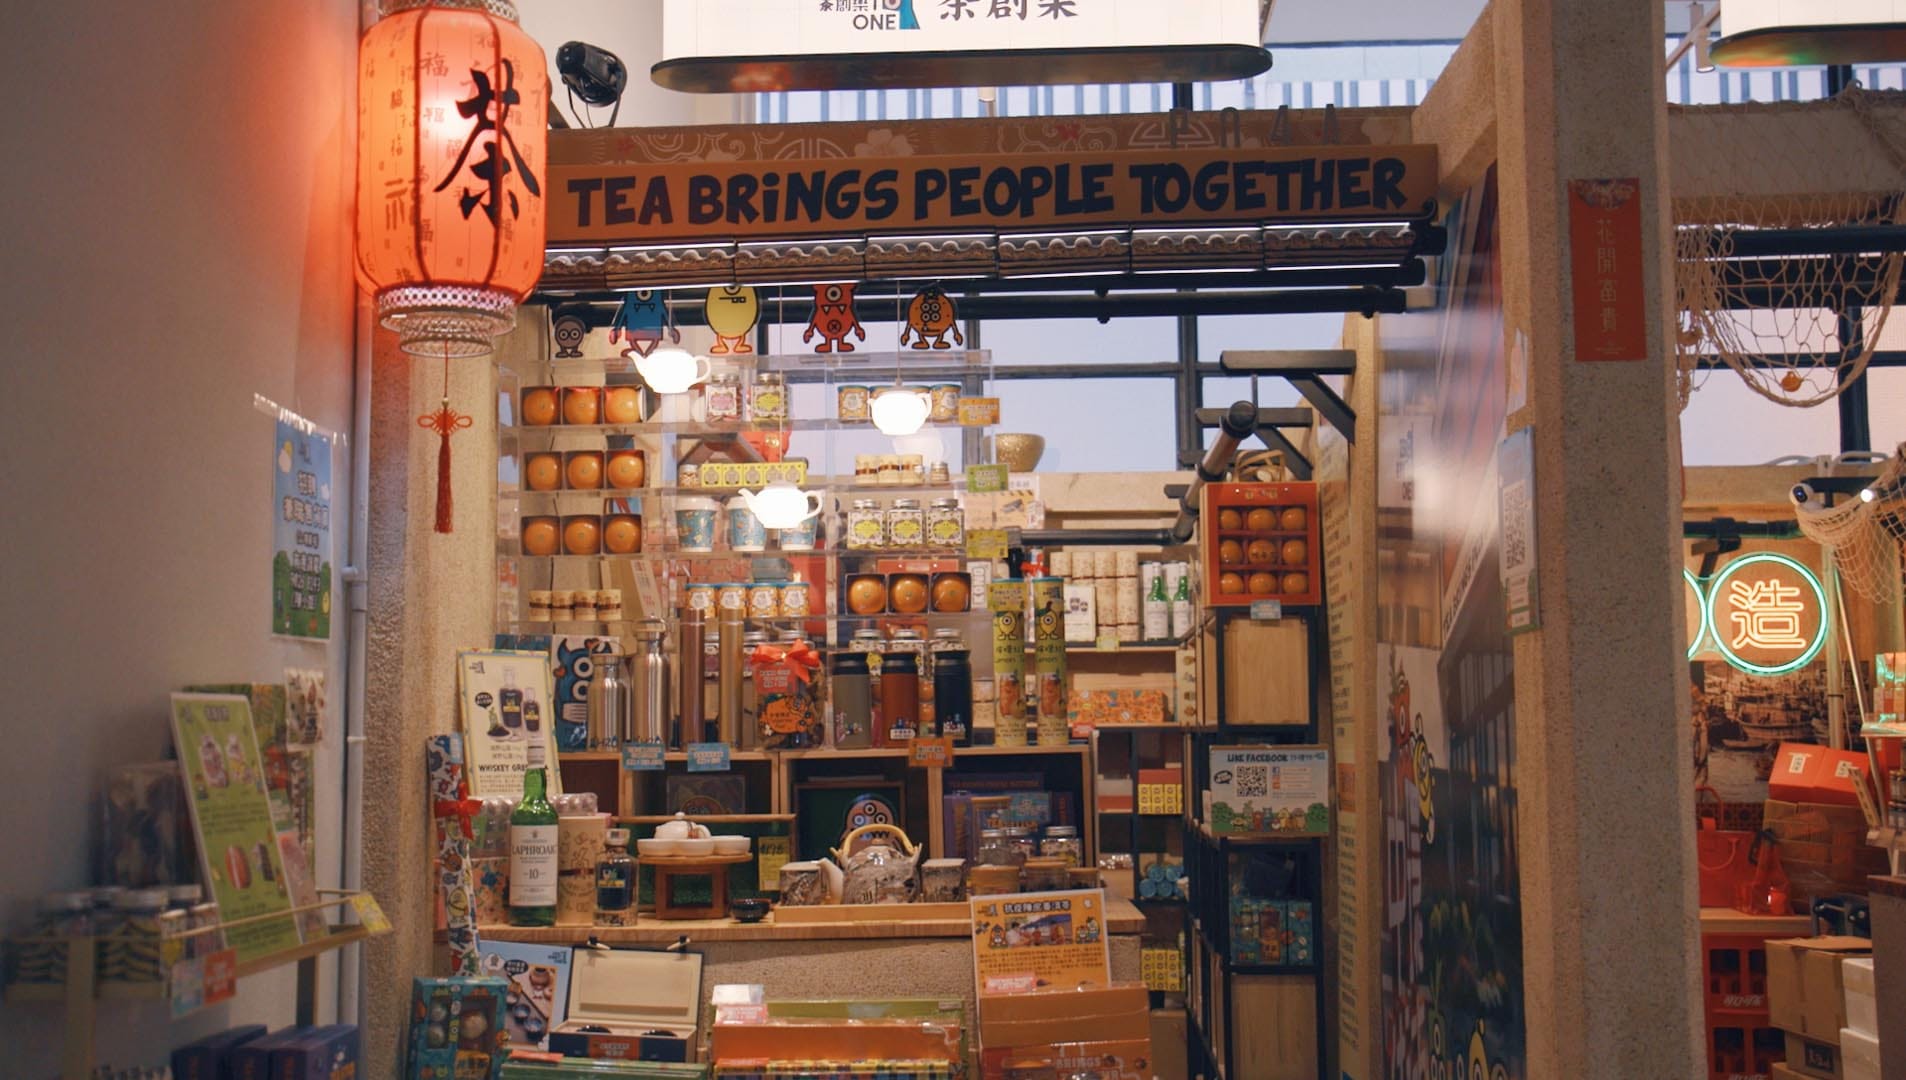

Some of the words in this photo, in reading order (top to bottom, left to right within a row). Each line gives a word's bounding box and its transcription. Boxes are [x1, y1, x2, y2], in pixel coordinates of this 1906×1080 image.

[853, 14, 896, 30] ONE
[433, 57, 541, 229] 茶
[567, 174, 673, 228] TEA
[914, 162, 1114, 220] PEOPLE
[1129, 157, 1408, 214] TOGETHER
[1728, 578, 1807, 650] 造
[1228, 753, 1244, 763] LIKE
[1246, 753, 1288, 763] FACEBOOK
[479, 764, 510, 773] WHISKEY
[528, 868, 539, 879] 10
